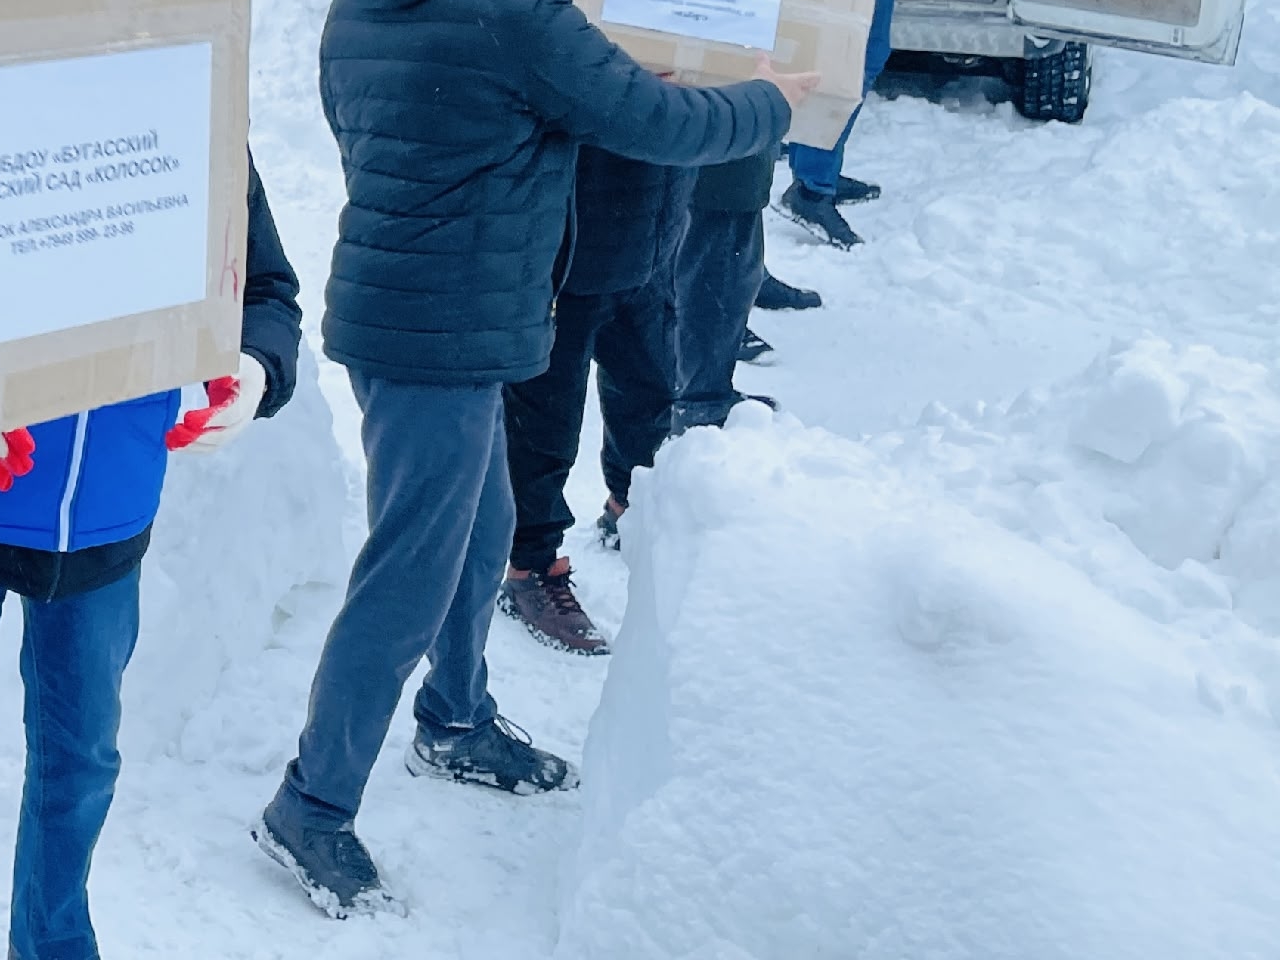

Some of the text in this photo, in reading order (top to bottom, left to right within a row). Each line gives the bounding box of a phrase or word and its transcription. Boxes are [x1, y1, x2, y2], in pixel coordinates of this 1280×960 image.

[52, 130, 159, 165] «БУГАССКИЙ
[45, 169, 82, 192] САД
[85, 155, 180, 184] «КОЛОСОК»
[18, 207, 103, 234] АЛЕКСАНДРА
[106, 193, 189, 220] ВАСИЛЬЕВНА
